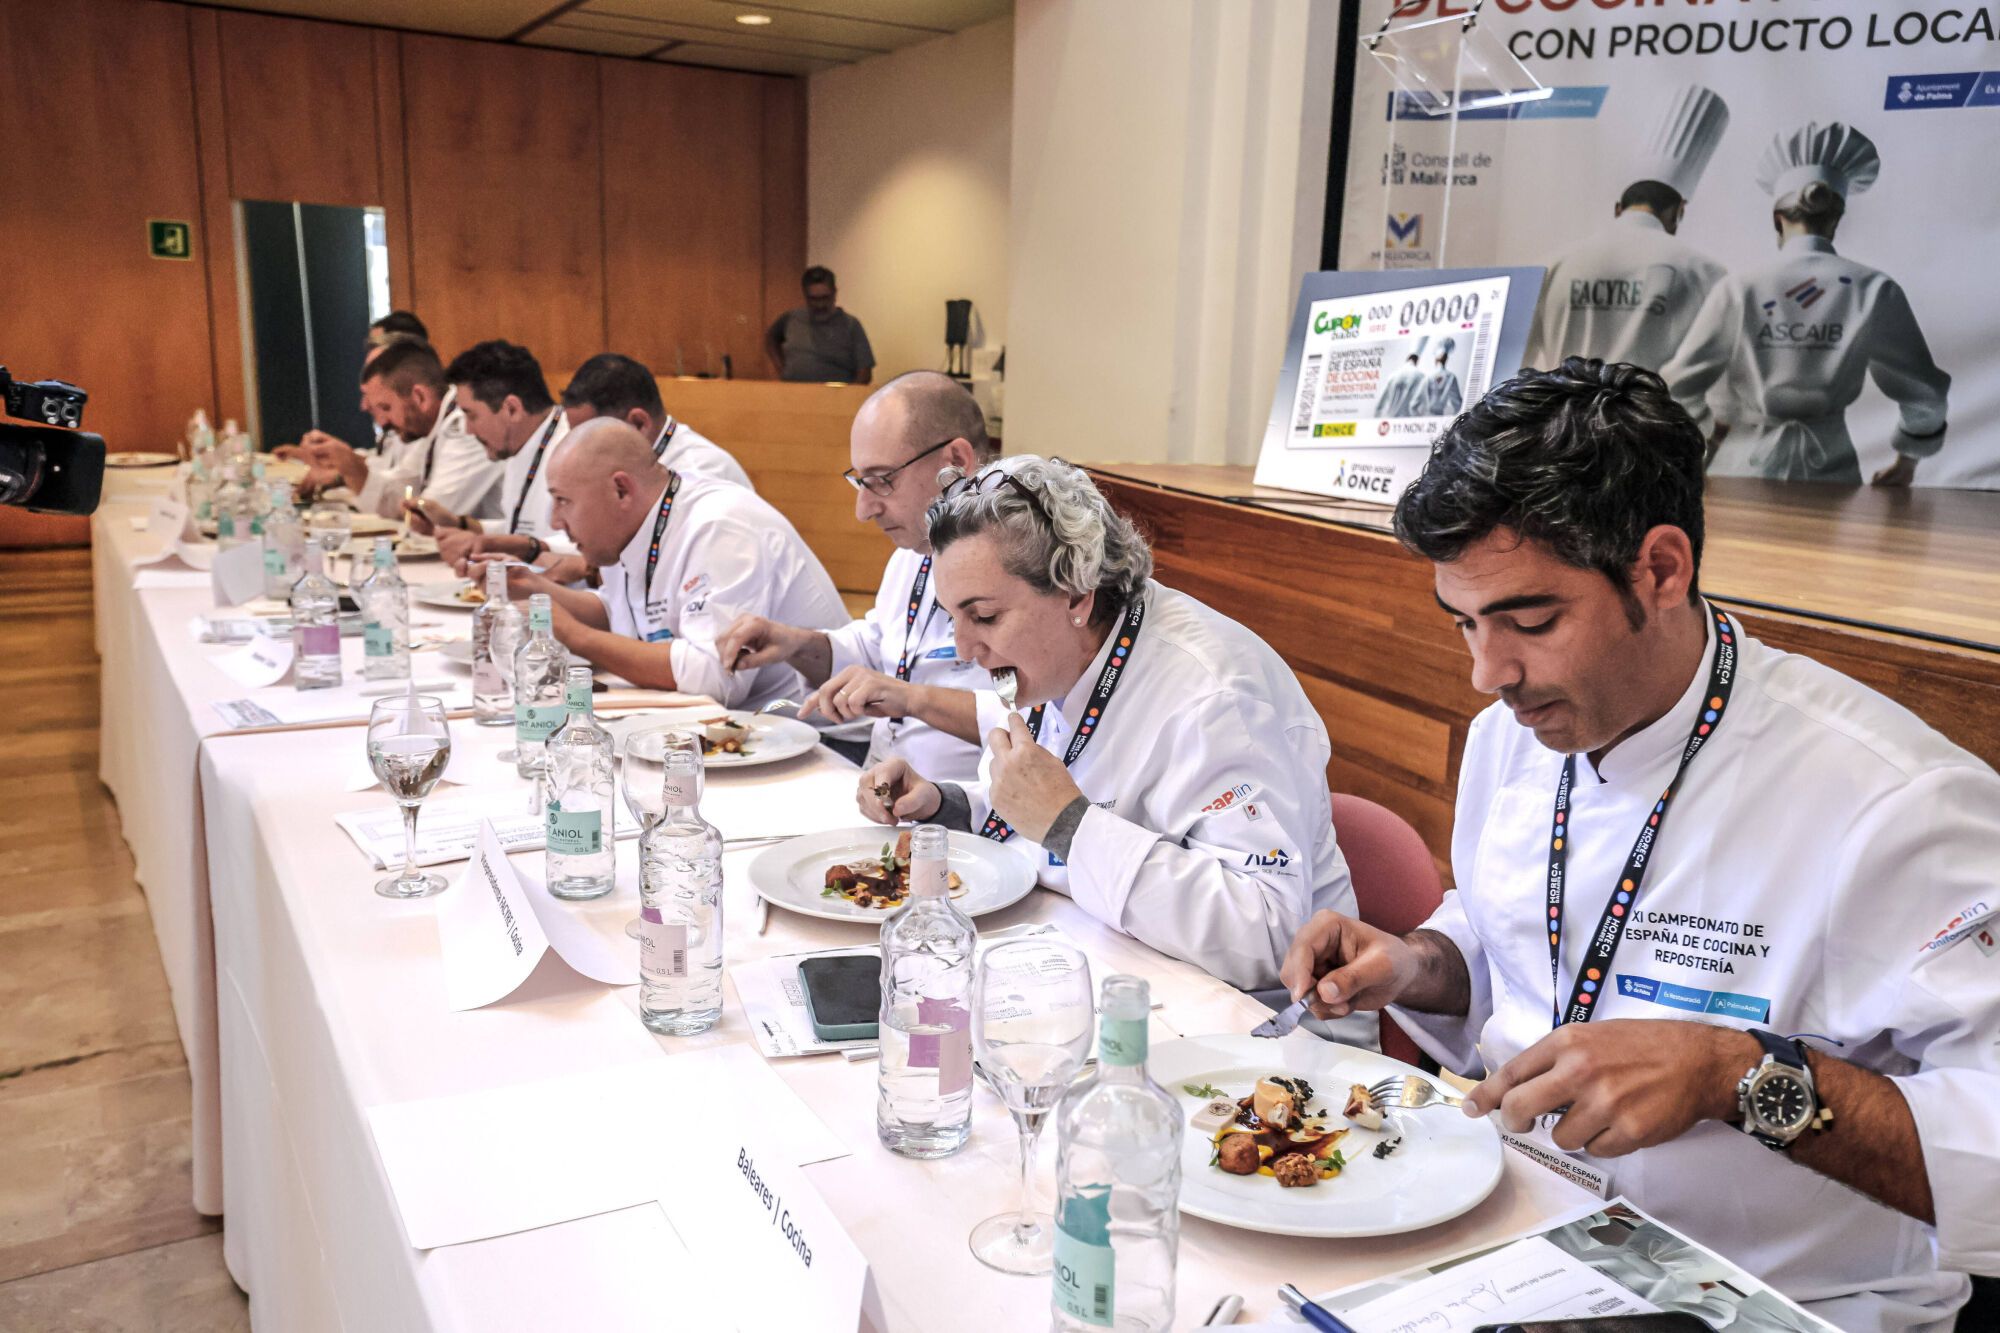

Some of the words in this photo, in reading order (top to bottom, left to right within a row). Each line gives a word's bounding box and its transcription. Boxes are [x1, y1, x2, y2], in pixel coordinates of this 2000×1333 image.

[1508, 27, 1596, 61] CON
[1608, 16, 1853, 58] PRODUCTO
[1866, 6, 2000, 48] LOCA
[1472, 151, 1492, 168] de
[1399, 292, 1479, 328] 00000
[1757, 322, 1844, 343] ASCAIB
[1347, 474, 1392, 494] ONCE
[1719, 645, 1734, 686] HORECA
[1100, 667, 1119, 698] HORECA
[530, 719, 557, 729] ANIOL
[551, 829, 584, 840] ANIOL
[1633, 826, 1655, 868] HORECA
[1549, 862, 1559, 904] HORECA
[500, 896, 514, 928] FACYRE
[510, 926, 524, 957] Cocina
[1598, 918, 1621, 958] HORECA
[1631, 909, 1644, 923] XI
[1647, 911, 1739, 935] CAMPEONATO
[1743, 923, 1765, 938] DE
[1625, 927, 1679, 945] ESPAÑA
[1682, 934, 1701, 949] DE
[1703, 938, 1757, 957] COCINA
[1760, 944, 1771, 958] Y
[1654, 949, 1735, 975] REPOSTERÍA
[1501, 1133, 1509, 1142] XI
[1509, 1137, 1560, 1166] CAMPEONATO
[1560, 1161, 1574, 1171] DE
[1572, 1165, 1603, 1185] ESPAÑA
[1549, 1164, 1601, 1192] REPOSTERÍA
[737, 1145, 774, 1211] Baleares
[781, 1209, 812, 1269] Cocina
